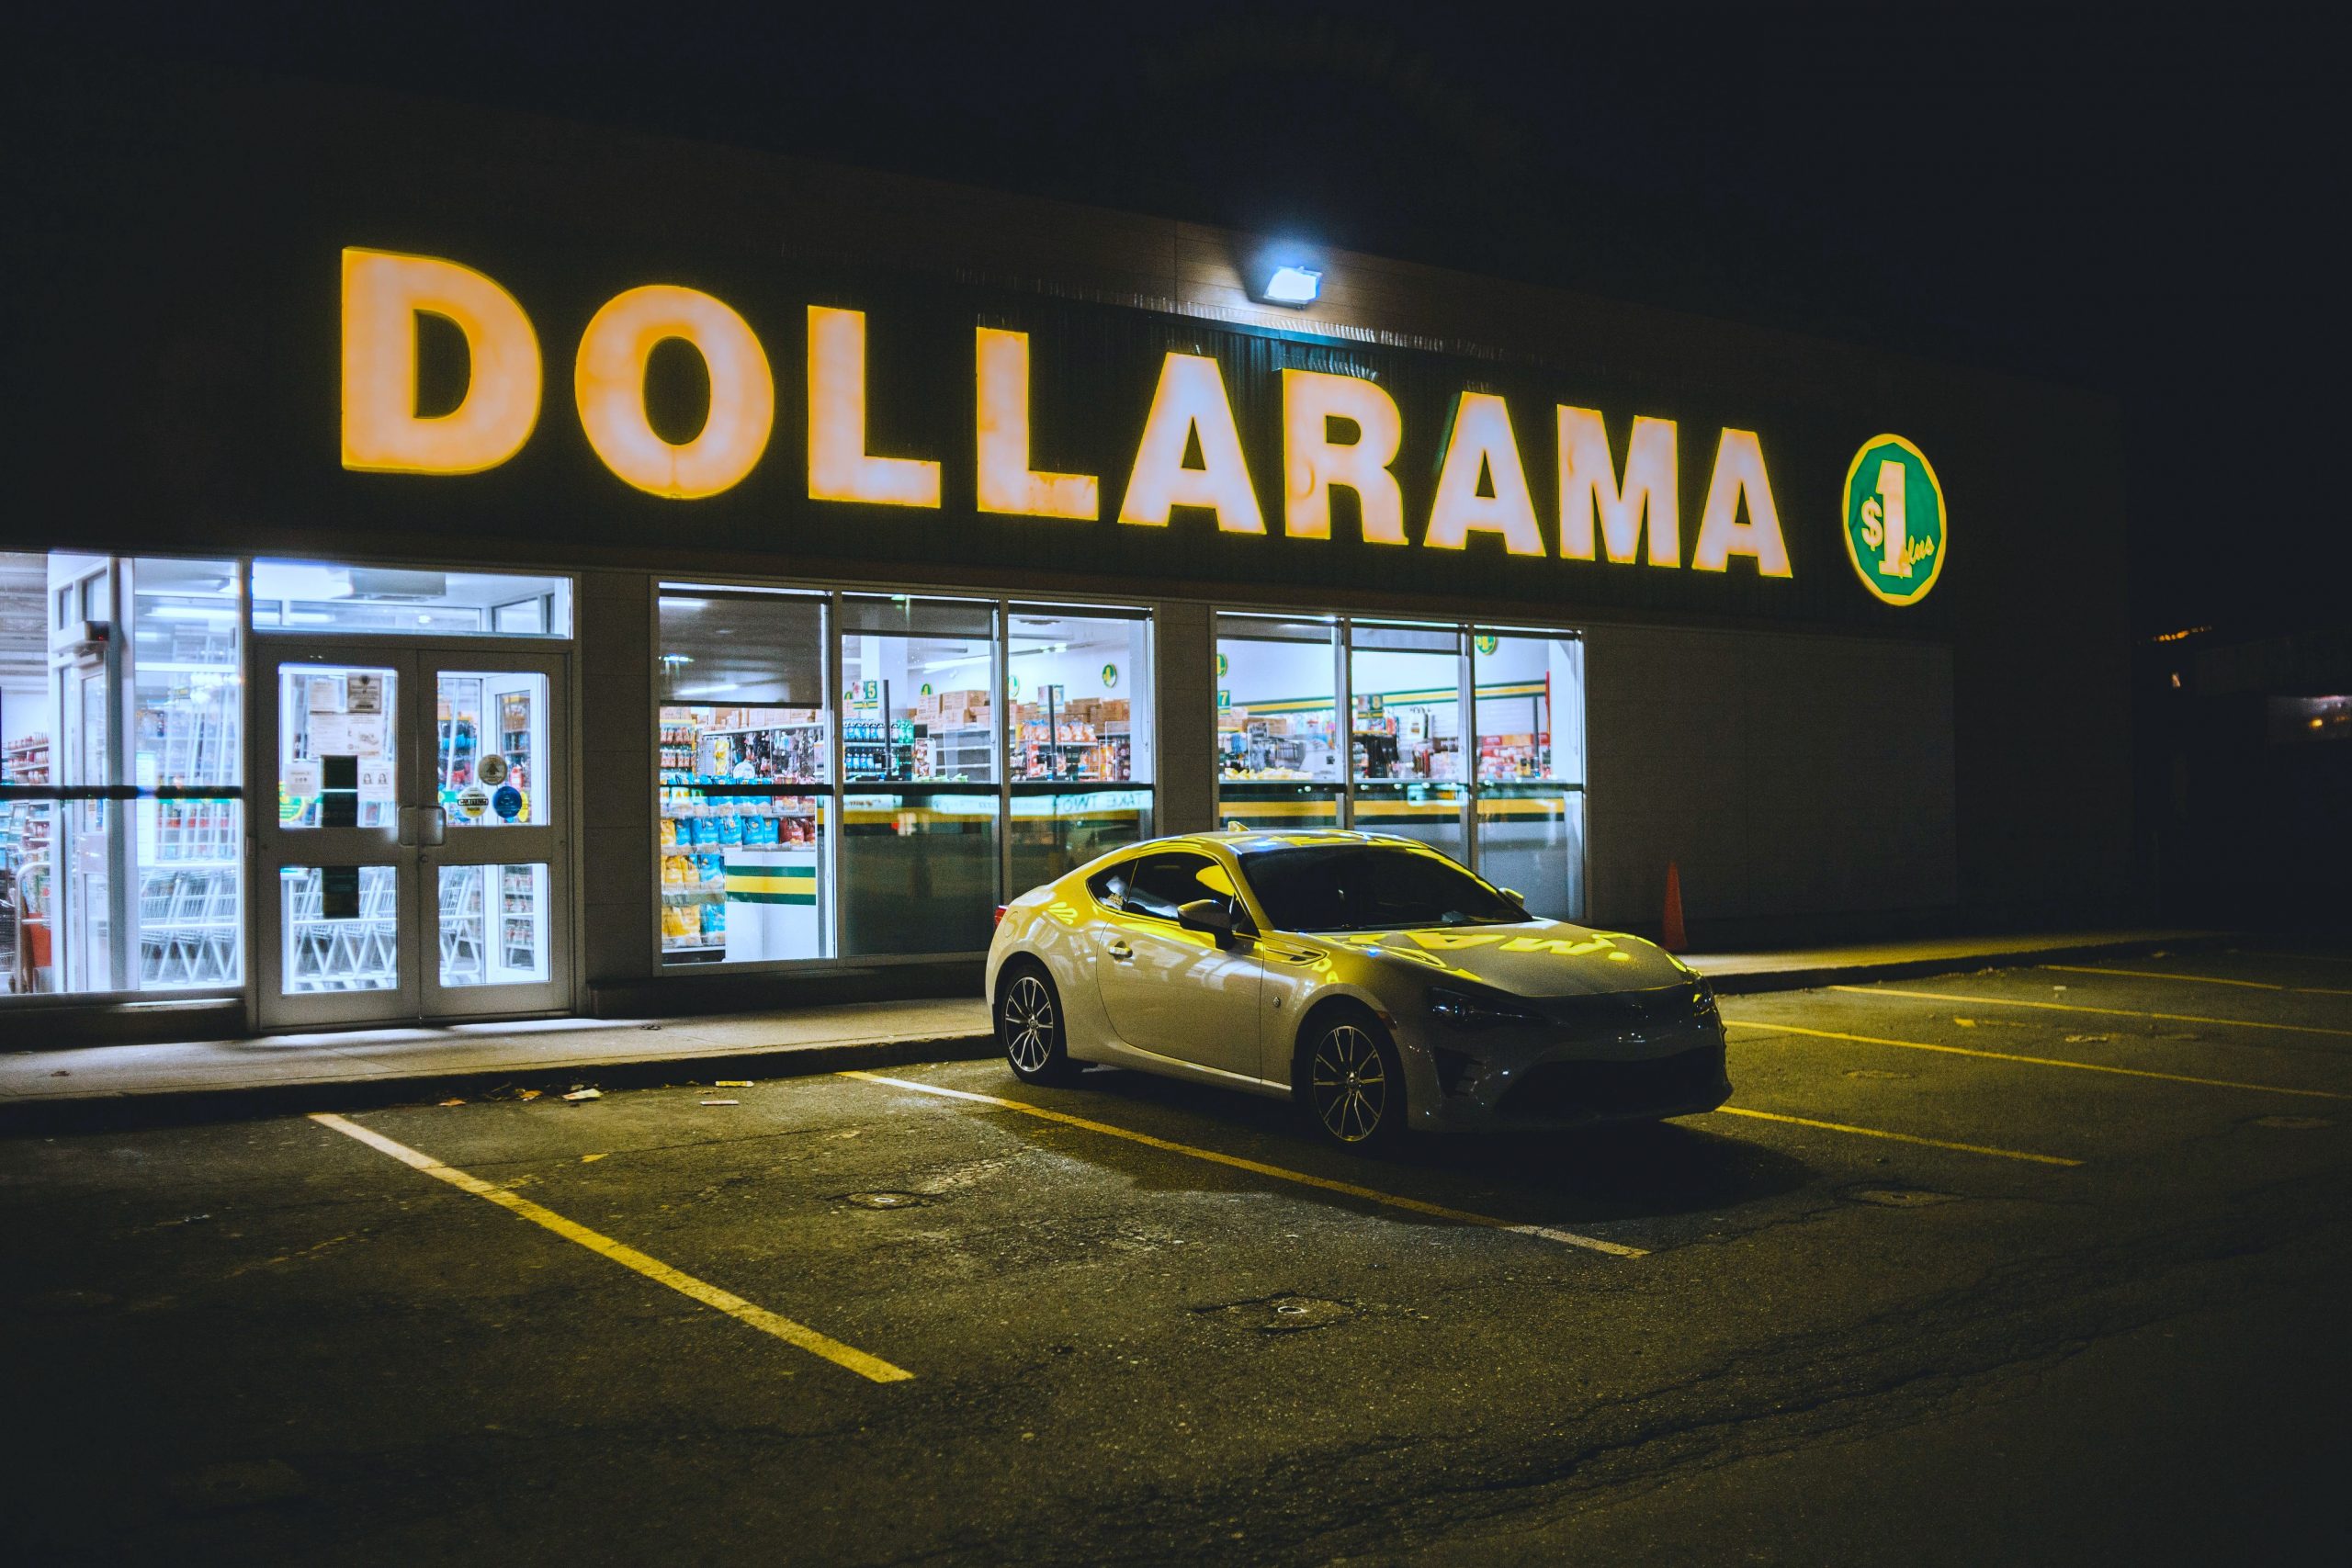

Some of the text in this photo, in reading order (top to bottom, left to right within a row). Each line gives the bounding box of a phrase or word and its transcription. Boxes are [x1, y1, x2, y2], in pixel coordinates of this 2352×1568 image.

[341, 245, 1794, 579] DOLLARAMA
[867, 682, 876, 698] 5
[1219, 691, 1228, 705] 7
